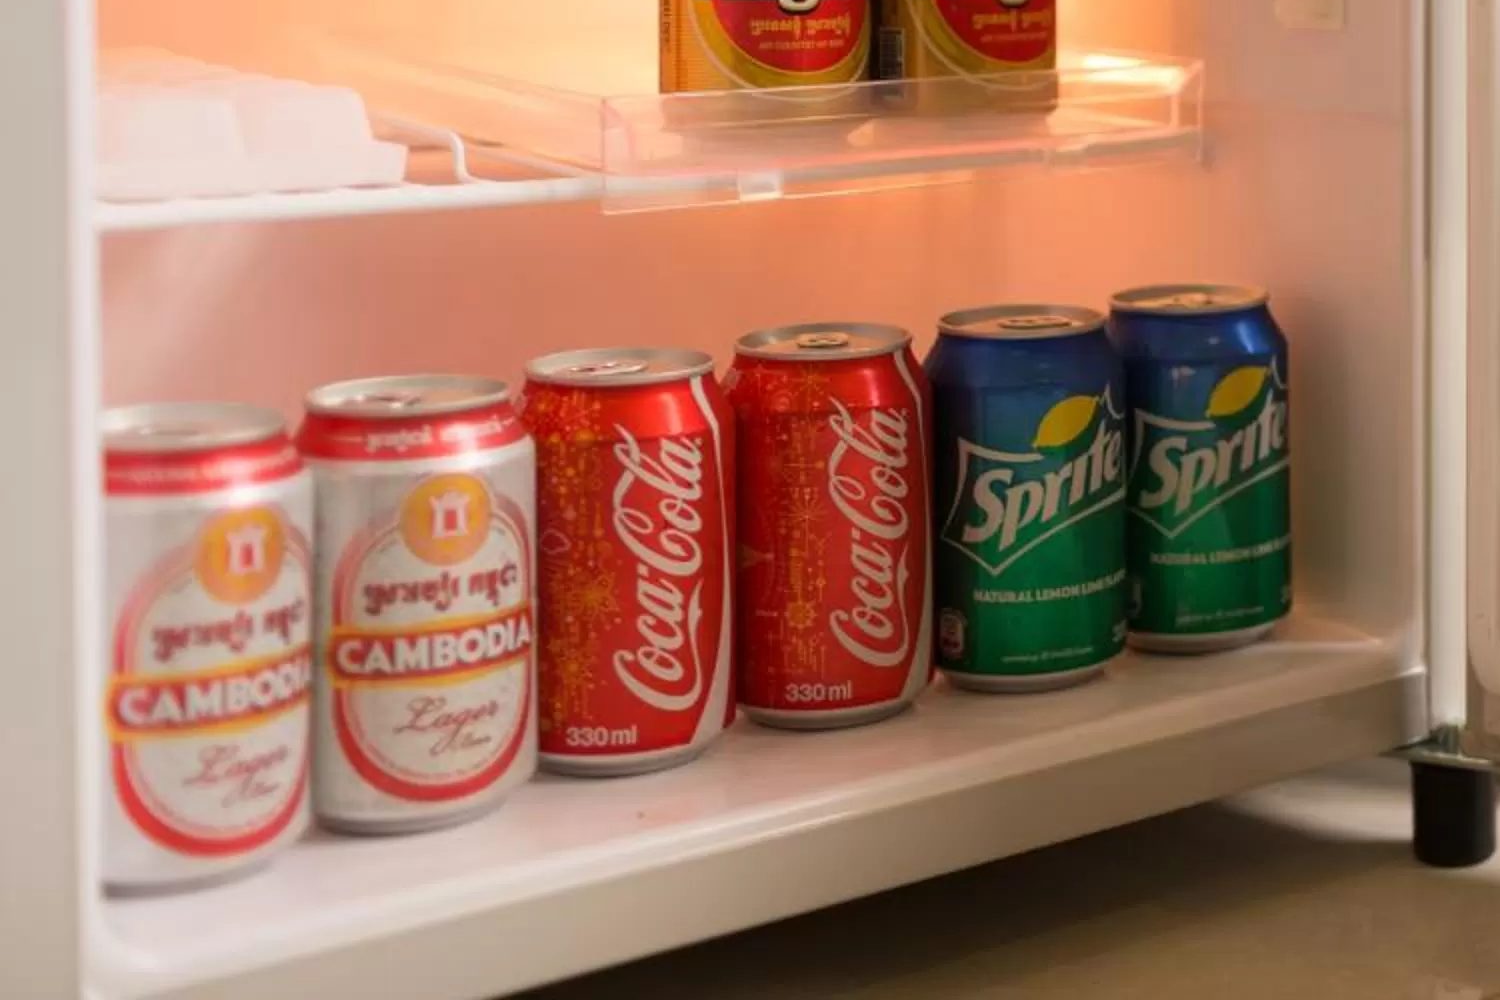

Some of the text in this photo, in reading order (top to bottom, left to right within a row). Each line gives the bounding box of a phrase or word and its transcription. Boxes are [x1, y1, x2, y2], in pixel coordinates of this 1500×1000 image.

[961, 418, 1122, 552] Sprite
[1140, 388, 1285, 516] Sprite
[612, 423, 704, 712] Coca-Cola
[827, 396, 909, 667] Coca-Cola
[973, 588, 1033, 603] NATURAL
[1036, 584, 1081, 600] LEMON
[336, 615, 532, 674] CAMBODIA
